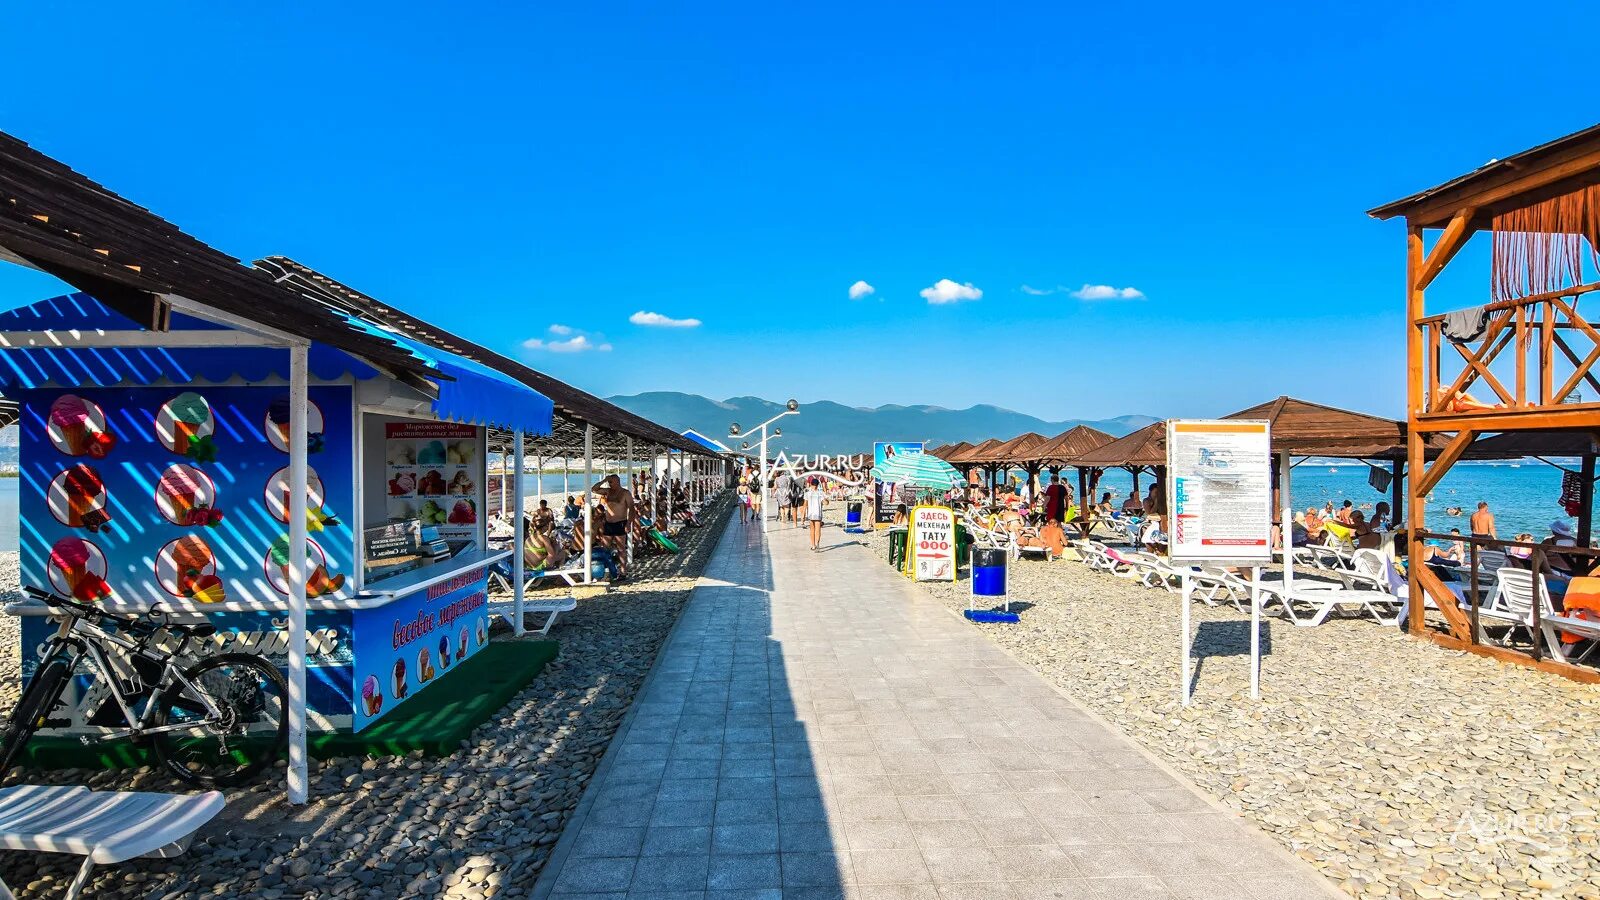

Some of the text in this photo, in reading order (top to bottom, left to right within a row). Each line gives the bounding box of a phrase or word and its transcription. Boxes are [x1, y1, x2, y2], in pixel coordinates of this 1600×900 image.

[920, 512, 948, 520] ЗДЕСЬ
[916, 522, 951, 530] МЕХЕНДИ
[922, 532, 946, 541] ТАТУ
